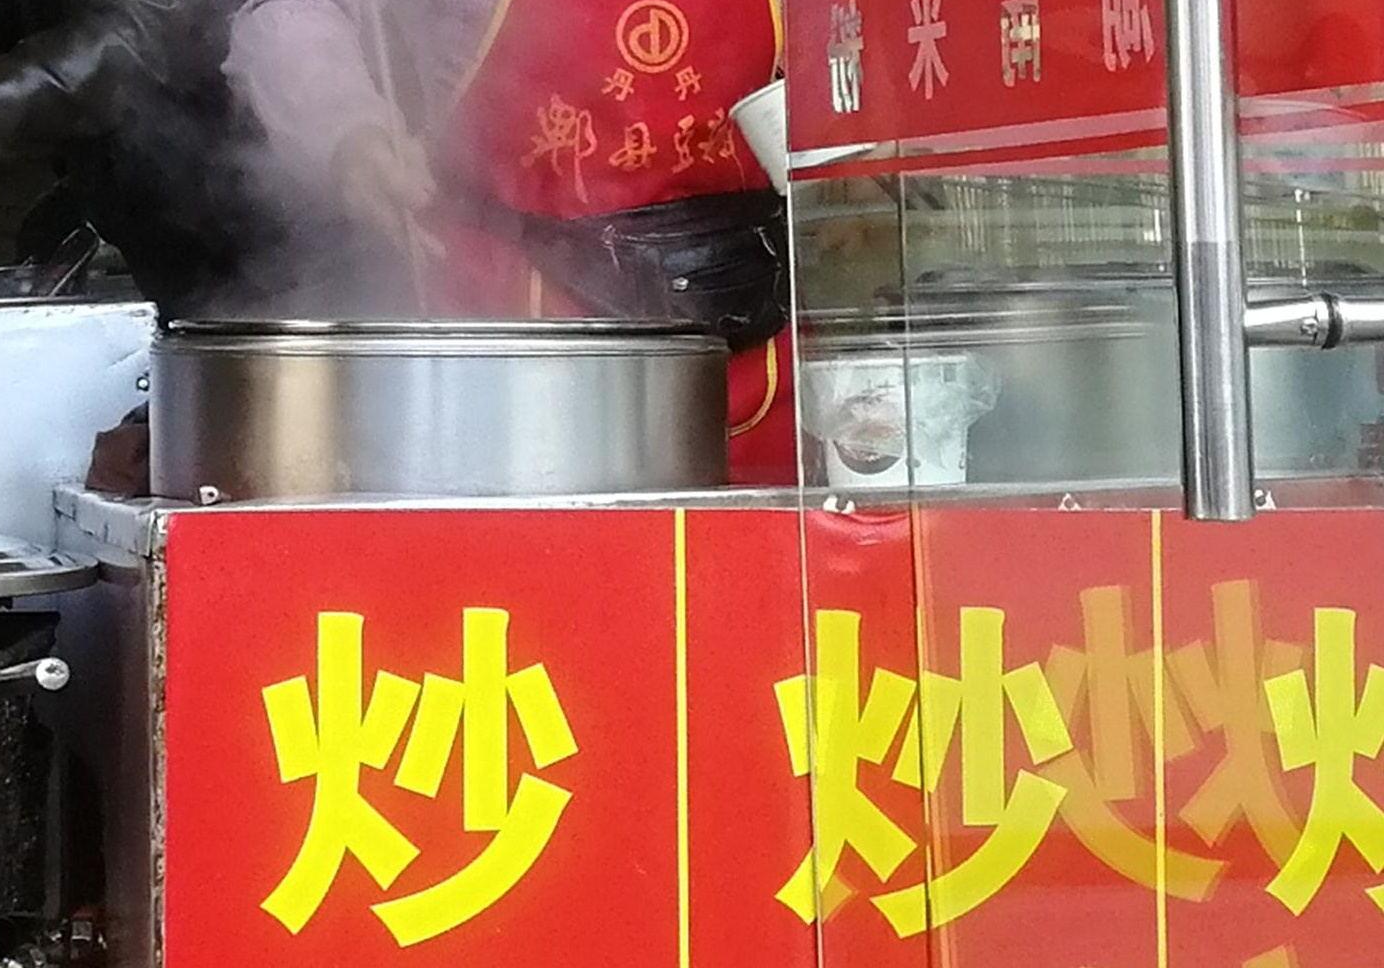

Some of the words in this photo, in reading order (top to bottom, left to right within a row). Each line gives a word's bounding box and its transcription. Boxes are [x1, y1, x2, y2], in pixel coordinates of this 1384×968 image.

[601, 65, 703, 101] 丹丹
[261, 607, 579, 948] 炒
[775, 607, 1071, 937] 炒
